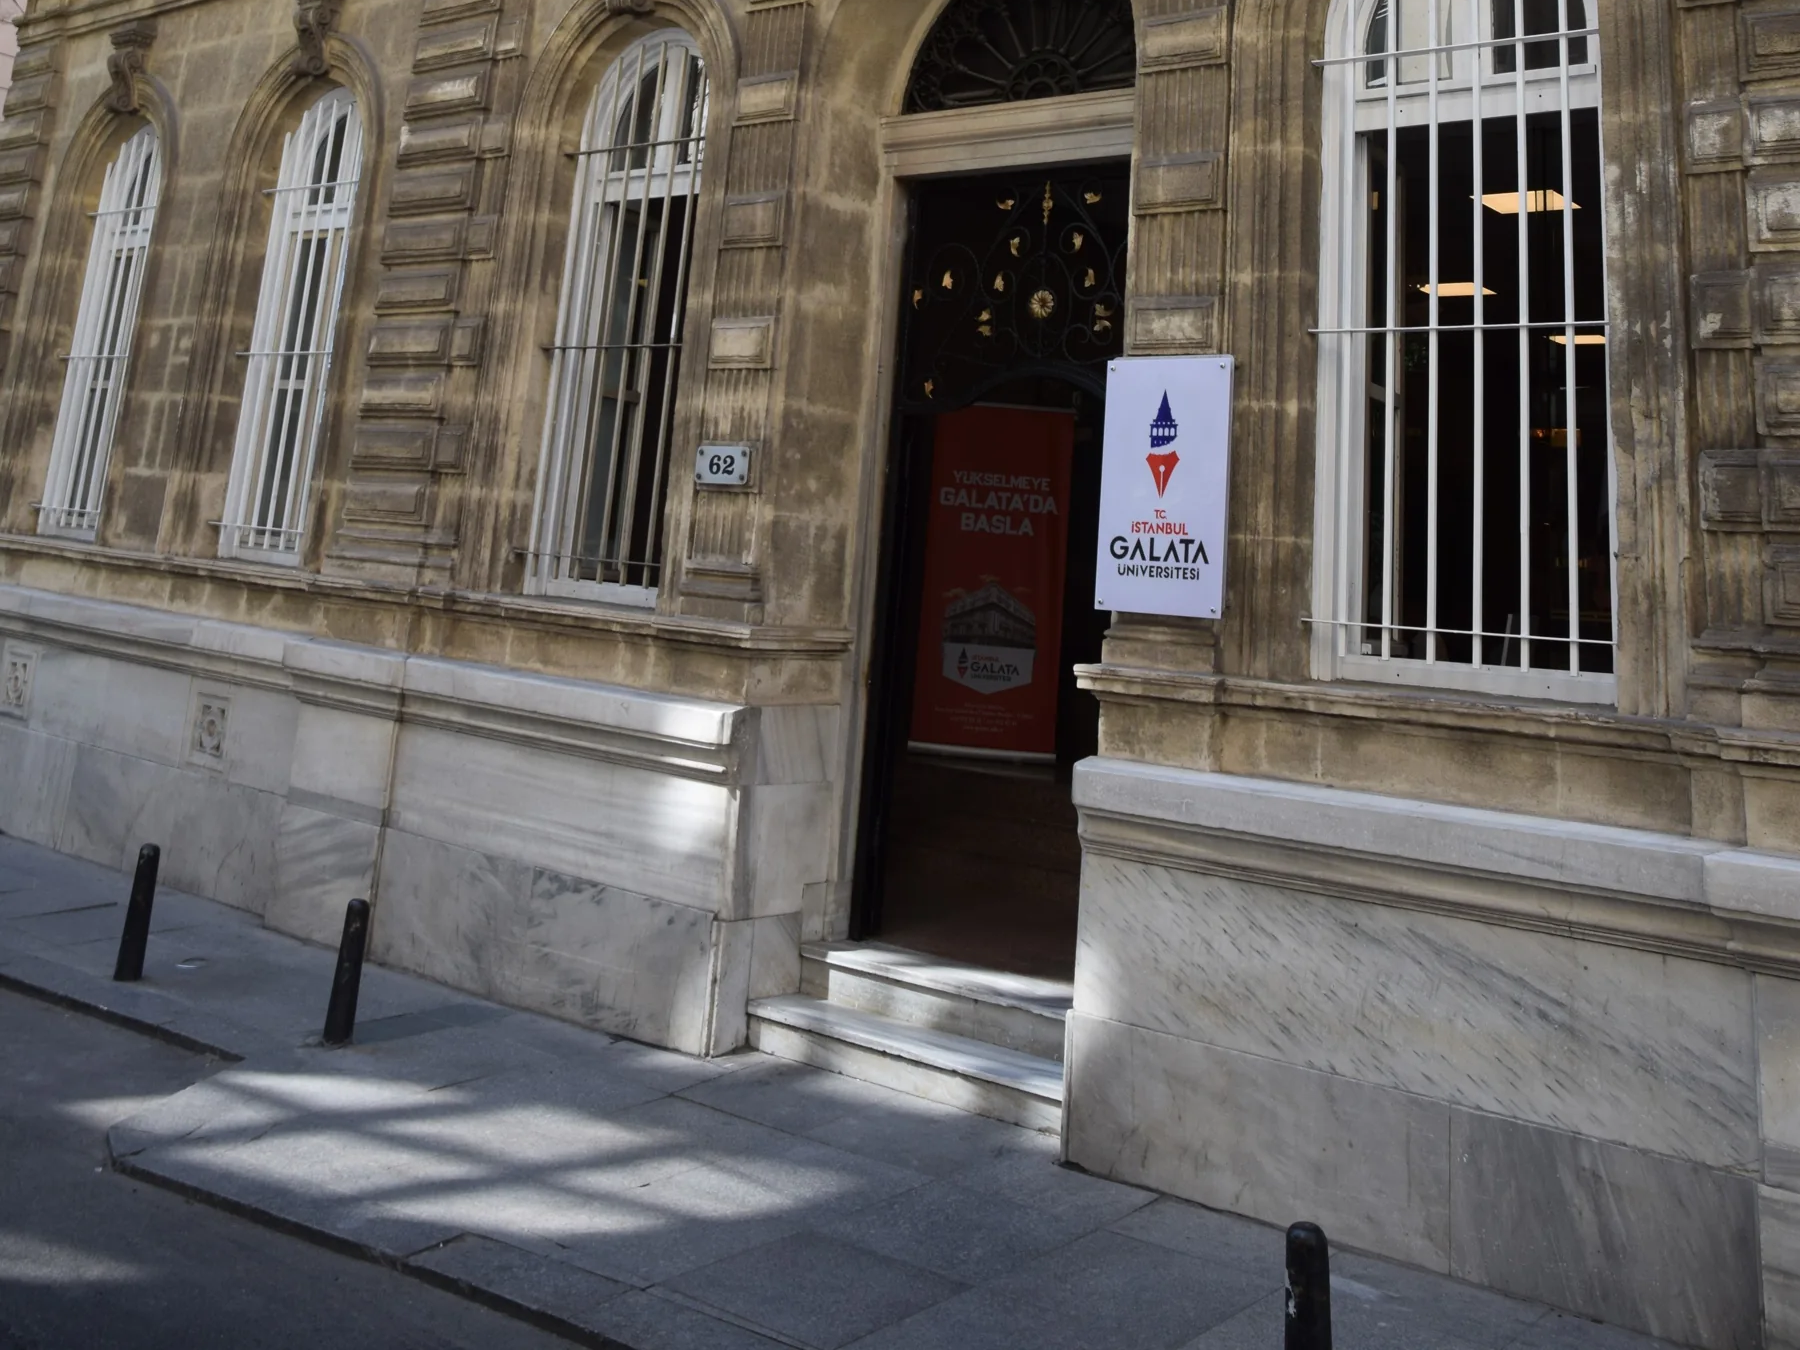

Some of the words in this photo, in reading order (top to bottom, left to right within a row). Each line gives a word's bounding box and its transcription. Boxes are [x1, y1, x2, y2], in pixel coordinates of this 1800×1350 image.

[708, 454, 735, 475] 62
[939, 486, 1059, 515] GALATA'DA
[1131, 521, 1188, 535] İSTANBUL
[1110, 536, 1209, 565] GALATA
[1117, 563, 1200, 581] ÜNİVERSİTESİ
[970, 661, 1020, 677] GALATA
